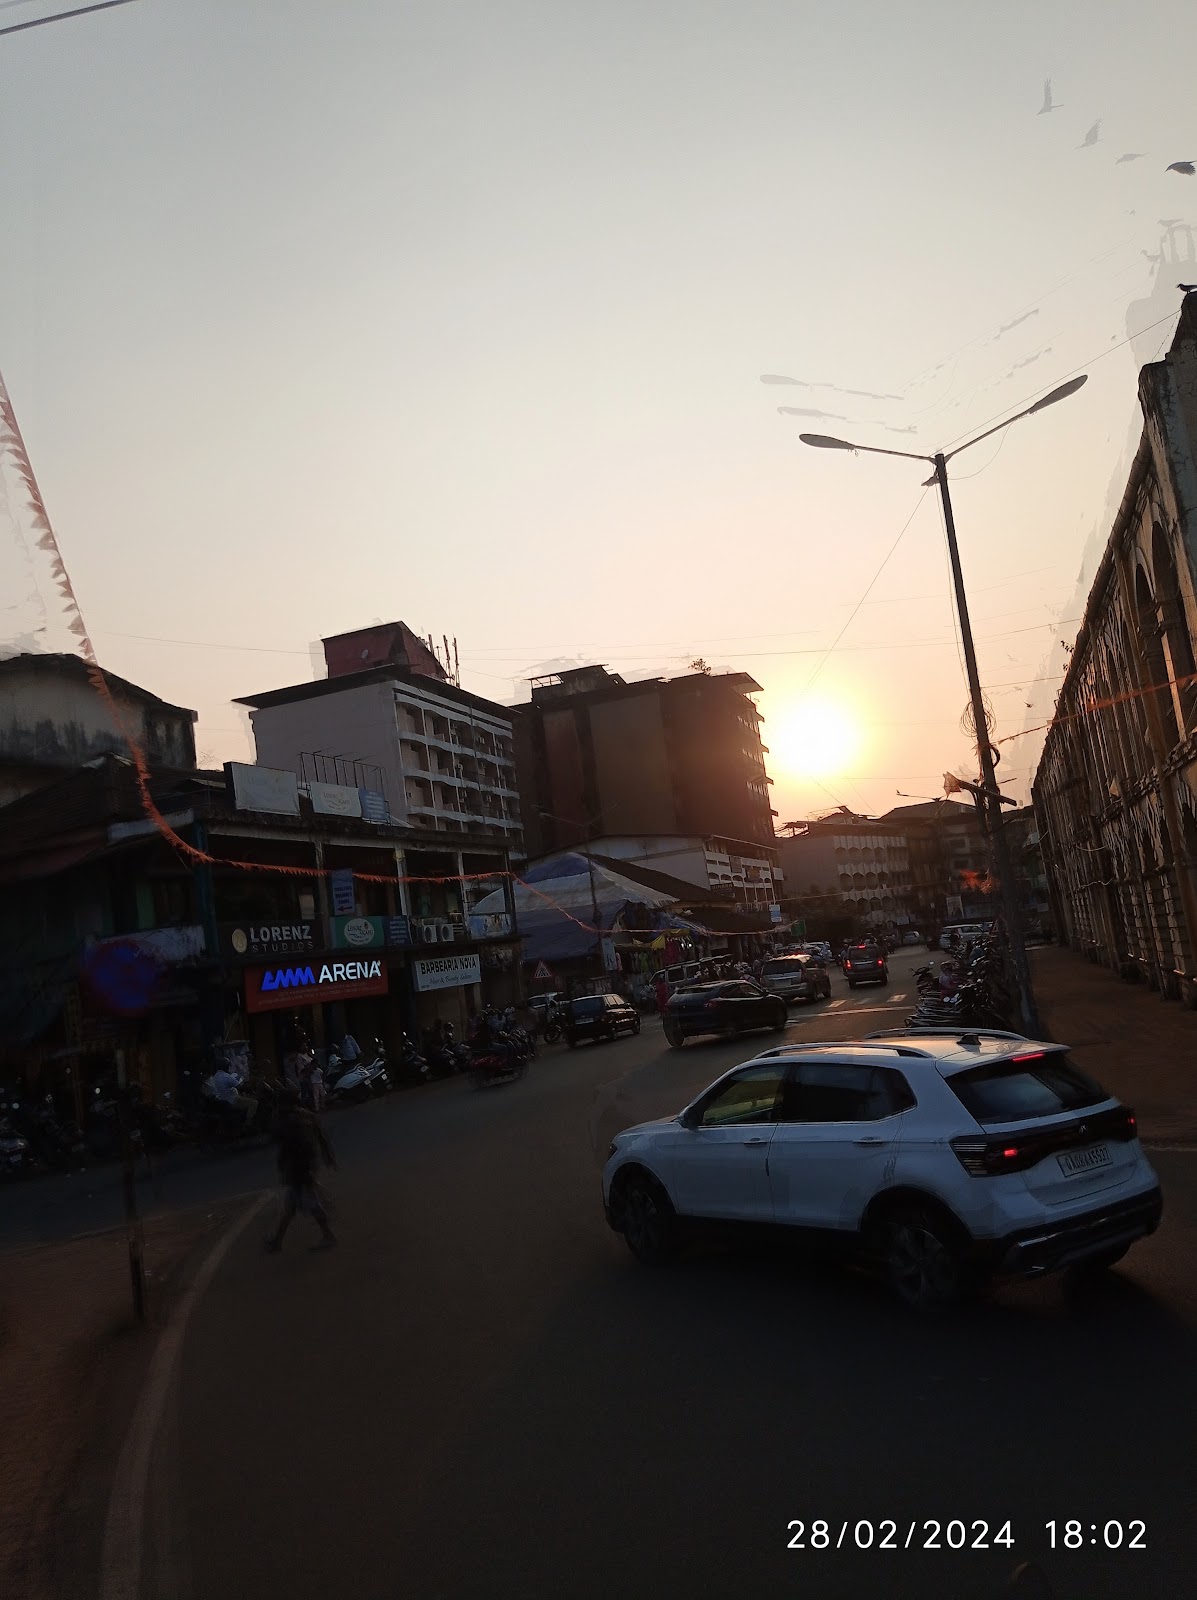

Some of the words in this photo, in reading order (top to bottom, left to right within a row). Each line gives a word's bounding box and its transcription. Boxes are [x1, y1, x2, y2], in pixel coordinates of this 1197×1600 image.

[249, 925, 312, 943] LORENZ
[251, 941, 314, 953] STUDIOS
[318, 960, 381, 984] ARENA
[420, 958, 459, 975] BARBEARIA
[459, 956, 477, 970] NOVA
